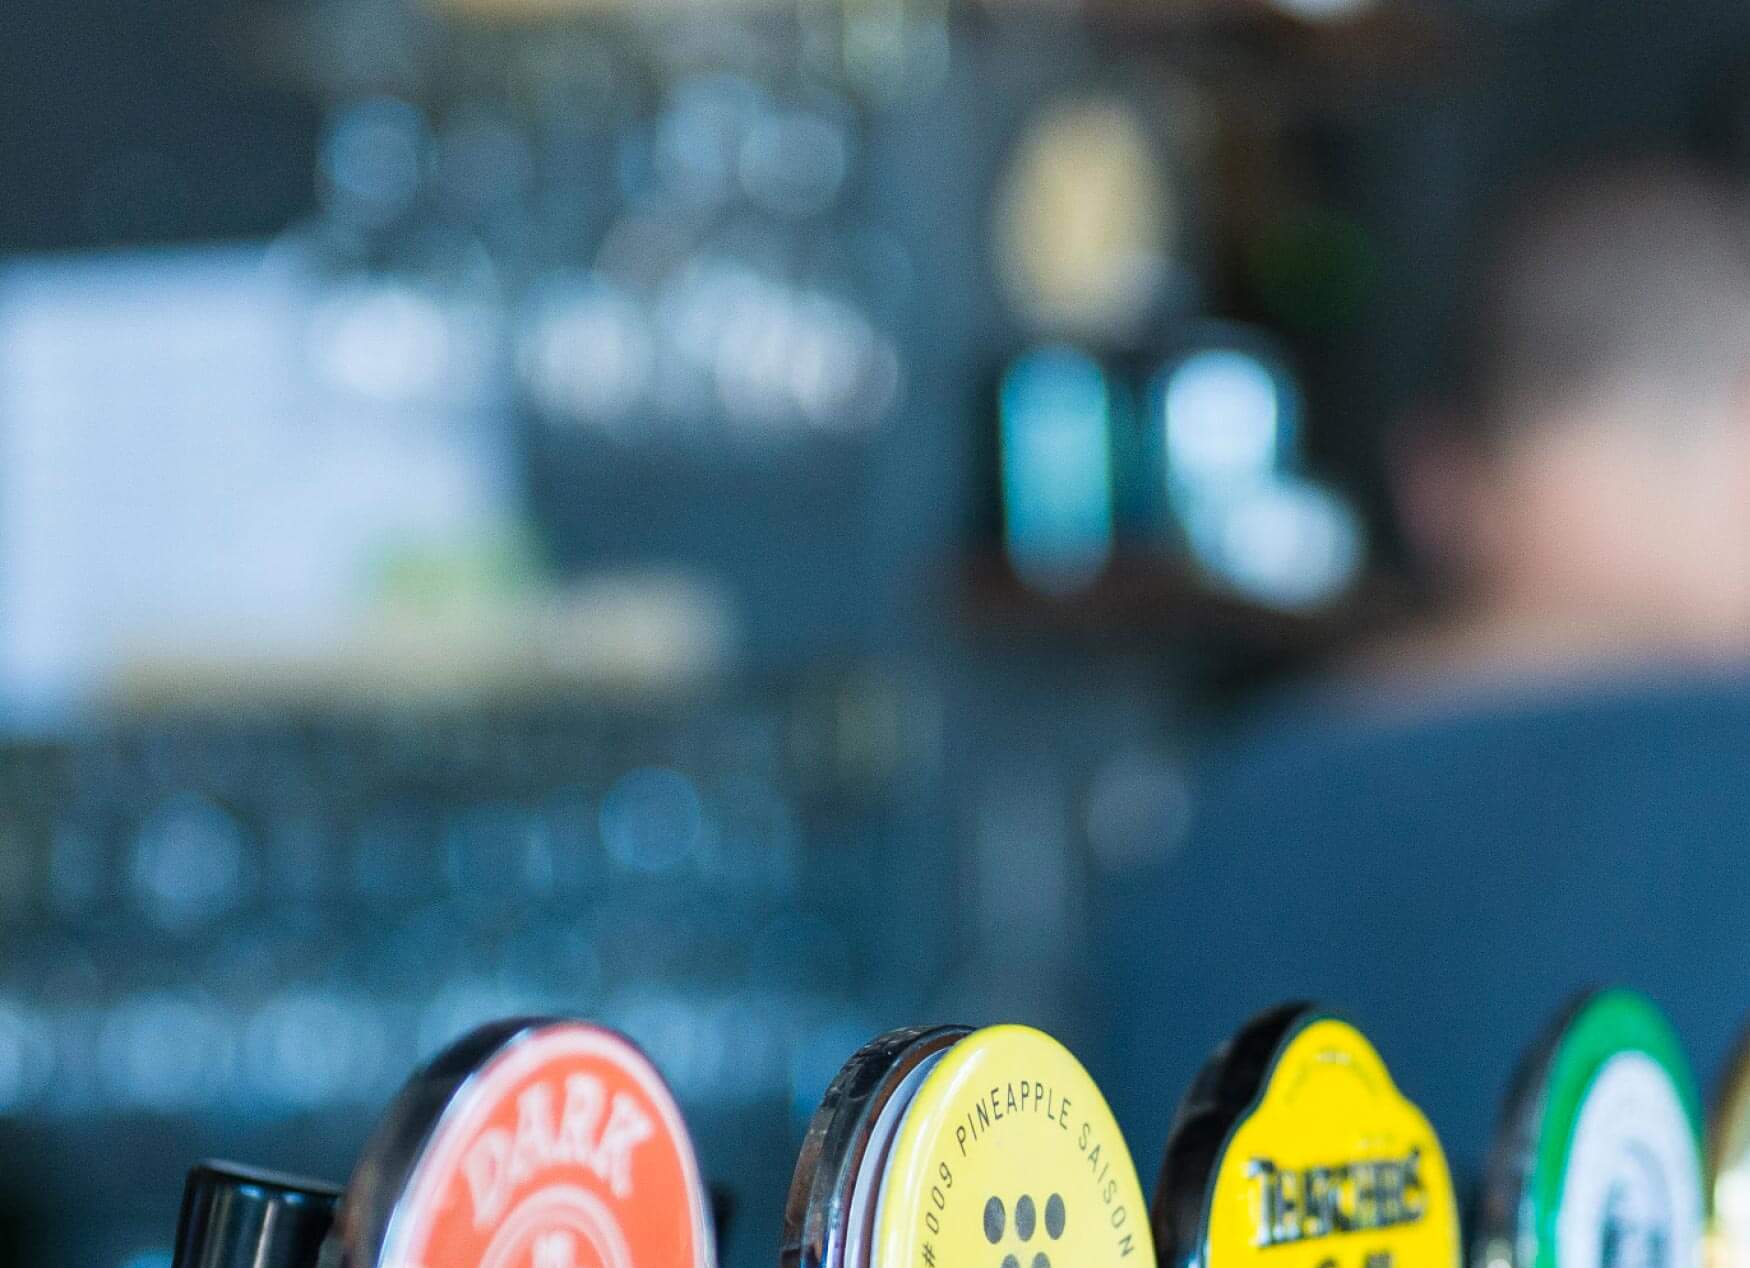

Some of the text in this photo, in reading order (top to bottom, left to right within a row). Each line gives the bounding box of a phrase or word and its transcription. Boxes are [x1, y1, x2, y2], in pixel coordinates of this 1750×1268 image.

[460, 1071, 654, 1229] DARK
[955, 1080, 1072, 1157] PINEAPPLE
[1078, 1122, 1135, 1258] SAISON
